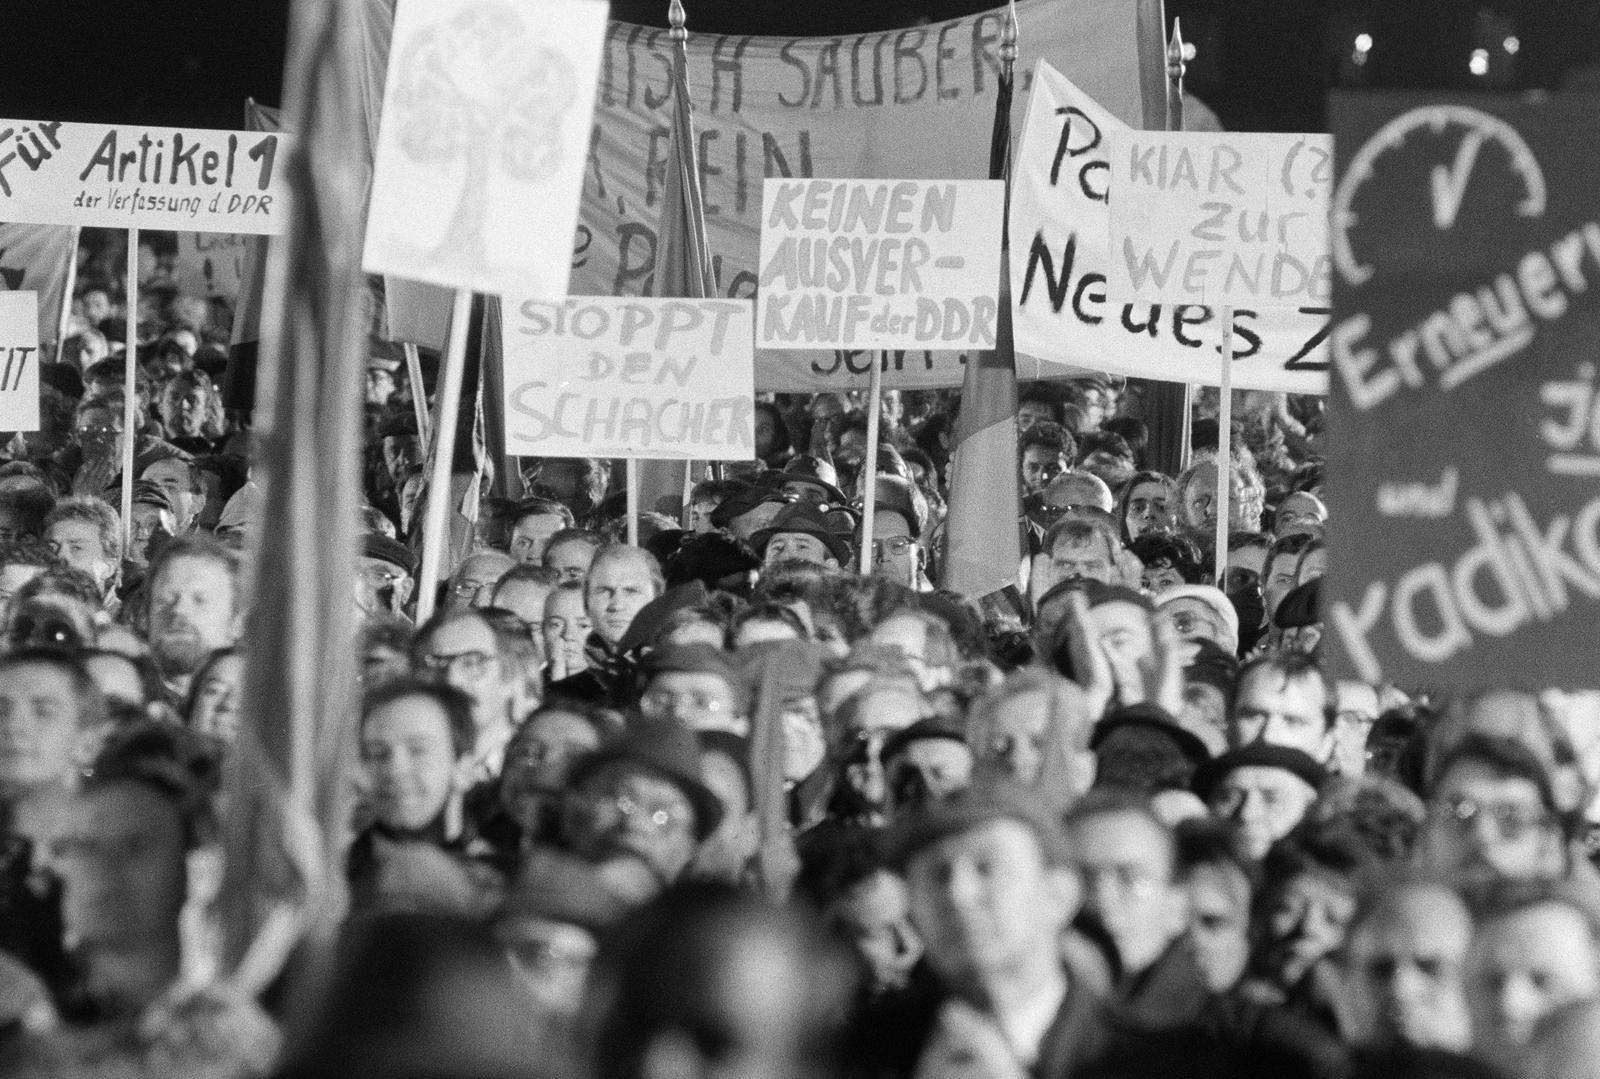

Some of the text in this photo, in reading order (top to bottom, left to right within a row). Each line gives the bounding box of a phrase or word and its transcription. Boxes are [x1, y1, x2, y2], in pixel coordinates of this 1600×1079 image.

[79, 129, 238, 188] Artikel
[248, 134, 278, 190] 1
[72, 190, 101, 208] der
[108, 187, 200, 218] Verfassung
[227, 193, 273, 215] DDR
[769, 181, 957, 234] KEINEN
[759, 236, 965, 295] AUSVER-
[518, 299, 746, 355] STOPPT
[763, 294, 998, 345] KAUF der DDR
[0, 346, 37, 391] IT
[578, 351, 697, 387] DEN
[508, 381, 752, 447] SCHACHER
